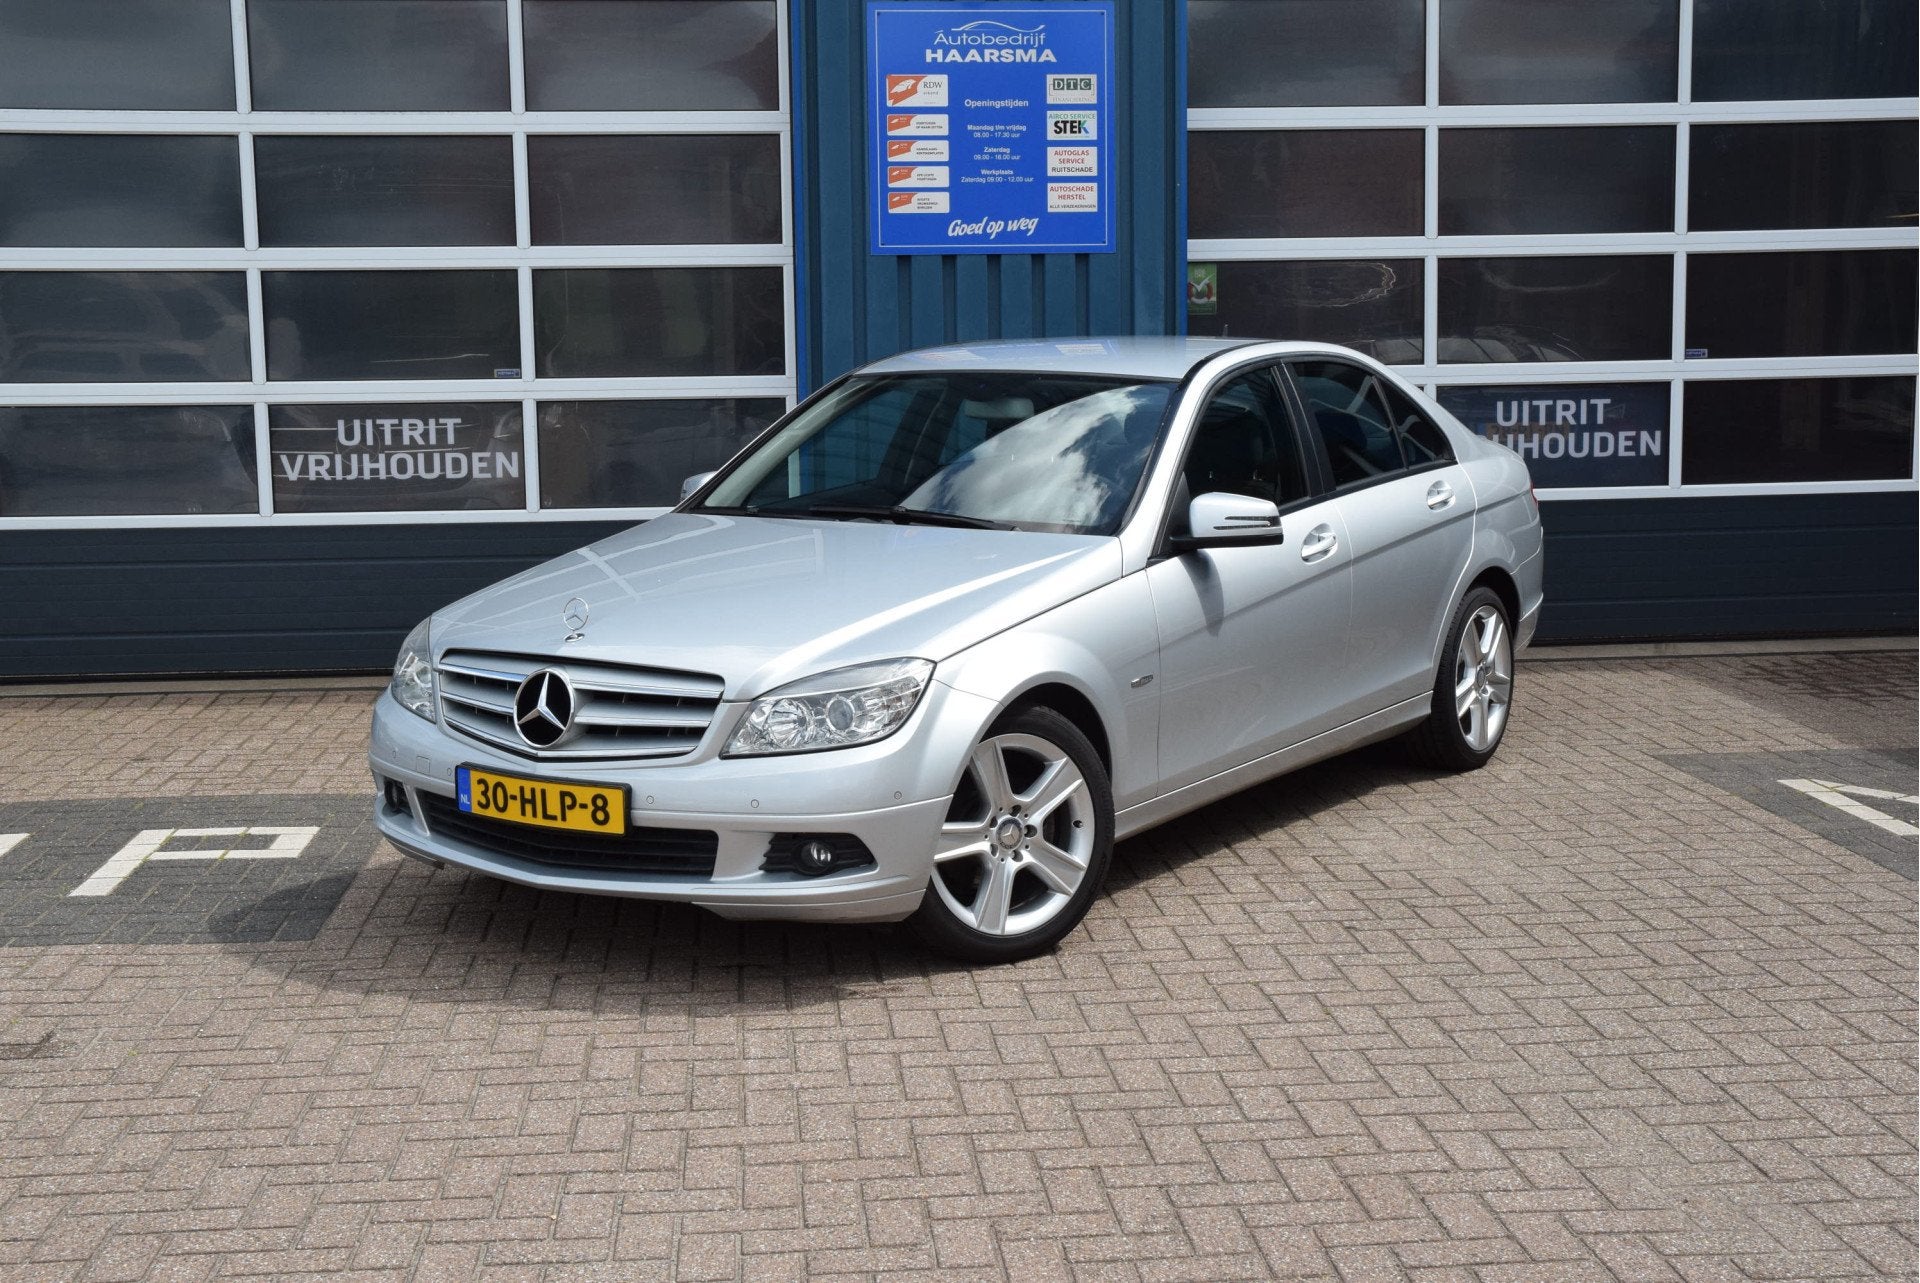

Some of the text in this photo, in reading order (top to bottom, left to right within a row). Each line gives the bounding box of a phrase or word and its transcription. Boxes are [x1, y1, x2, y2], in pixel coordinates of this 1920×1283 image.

[933, 31, 1046, 48] Autobedrijf
[925, 48, 1057, 63] HAARSMA
[923, 81, 942, 89] RDW
[1053, 78, 1092, 91] DTC
[964, 98, 1029, 109] Openingstijden
[967, 124, 994, 132] Maandag
[1006, 124, 1027, 132] vrijdag
[1053, 120, 1090, 134] STEK
[983, 146, 1011, 154] Zaterdag
[1058, 157, 1085, 165] SERVICE
[980, 168, 1014, 176] Werkplaats
[960, 176, 986, 184] Zaterdag
[1049, 185, 1095, 193] AUTOSCHADE
[1057, 193, 1087, 201] HERSTEL
[947, 216, 1040, 240] Goed op weg
[1496, 398, 1612, 427] UITRIT
[337, 418, 462, 446] UITRIT
[279, 451, 520, 481] VRIJHOUDEN
[460, 794, 471, 805] NL
[476, 778, 611, 827] 30-HLP-8
